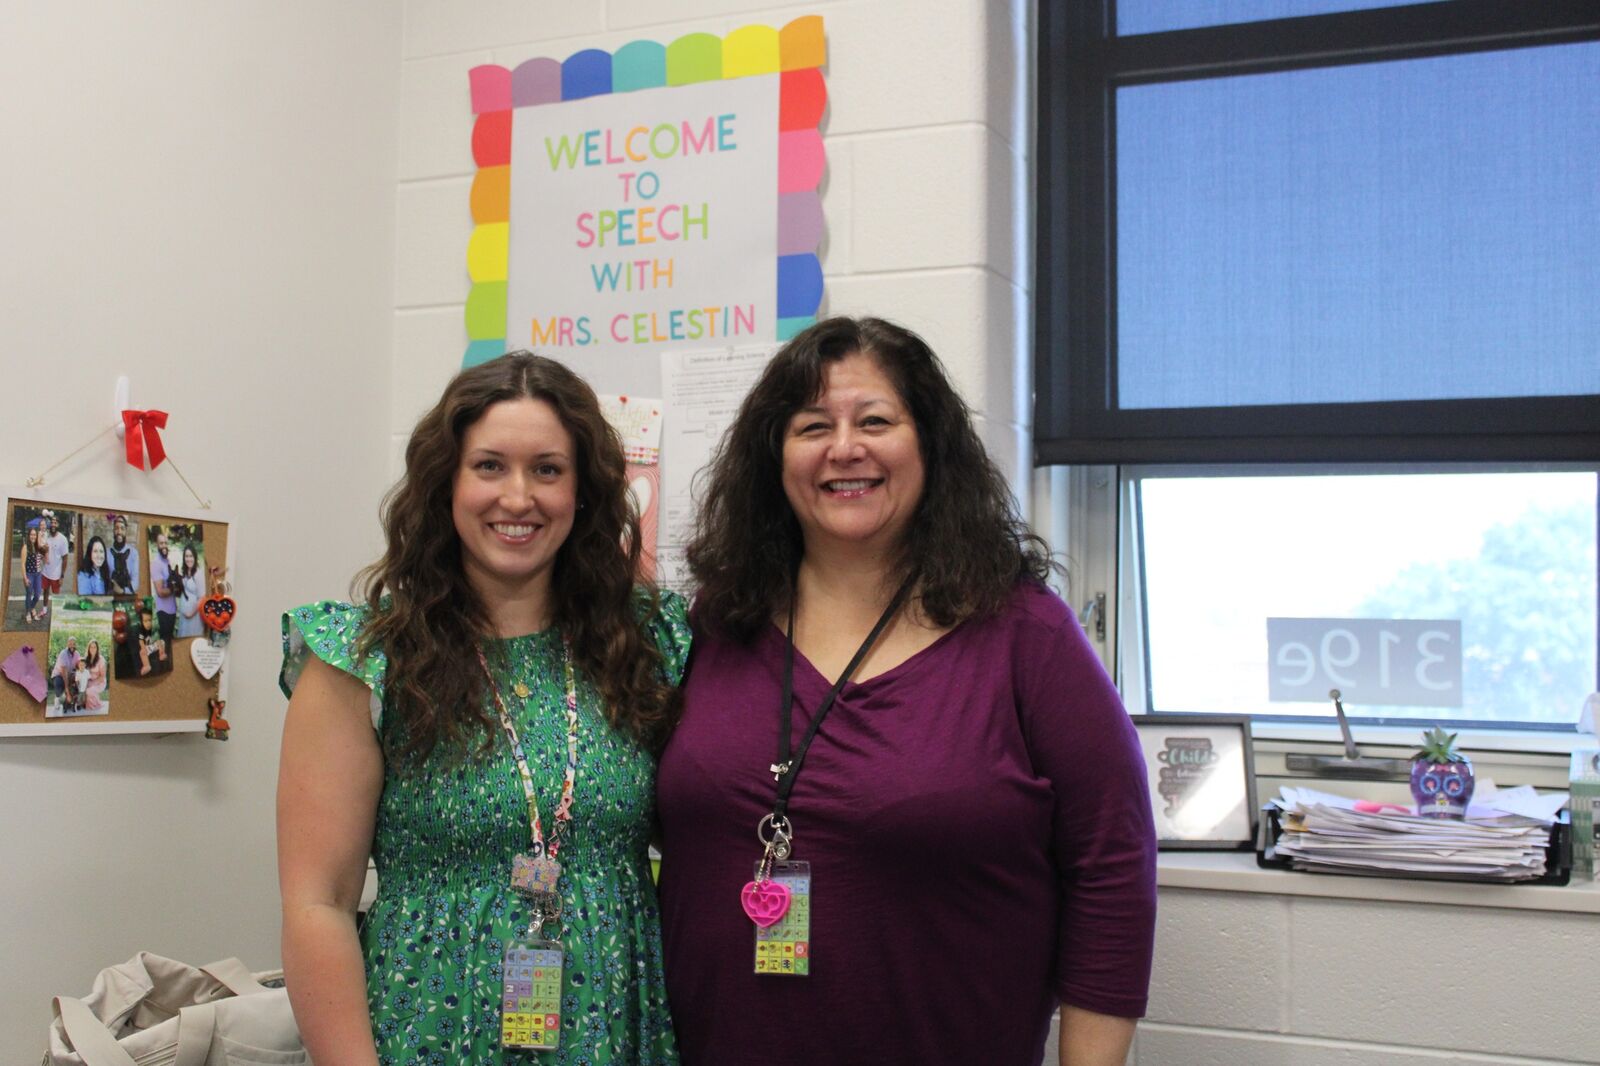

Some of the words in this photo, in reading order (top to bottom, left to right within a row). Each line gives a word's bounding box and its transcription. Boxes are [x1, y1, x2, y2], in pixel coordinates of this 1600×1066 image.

[545, 113, 737, 170] WELCOME
[618, 171, 660, 202] TO
[576, 202, 709, 249] SPEECH
[591, 257, 674, 293] WITH
[530, 315, 599, 347] MRS.
[610, 303, 755, 343] CELESTIN
[1169, 747, 1210, 765] Child
